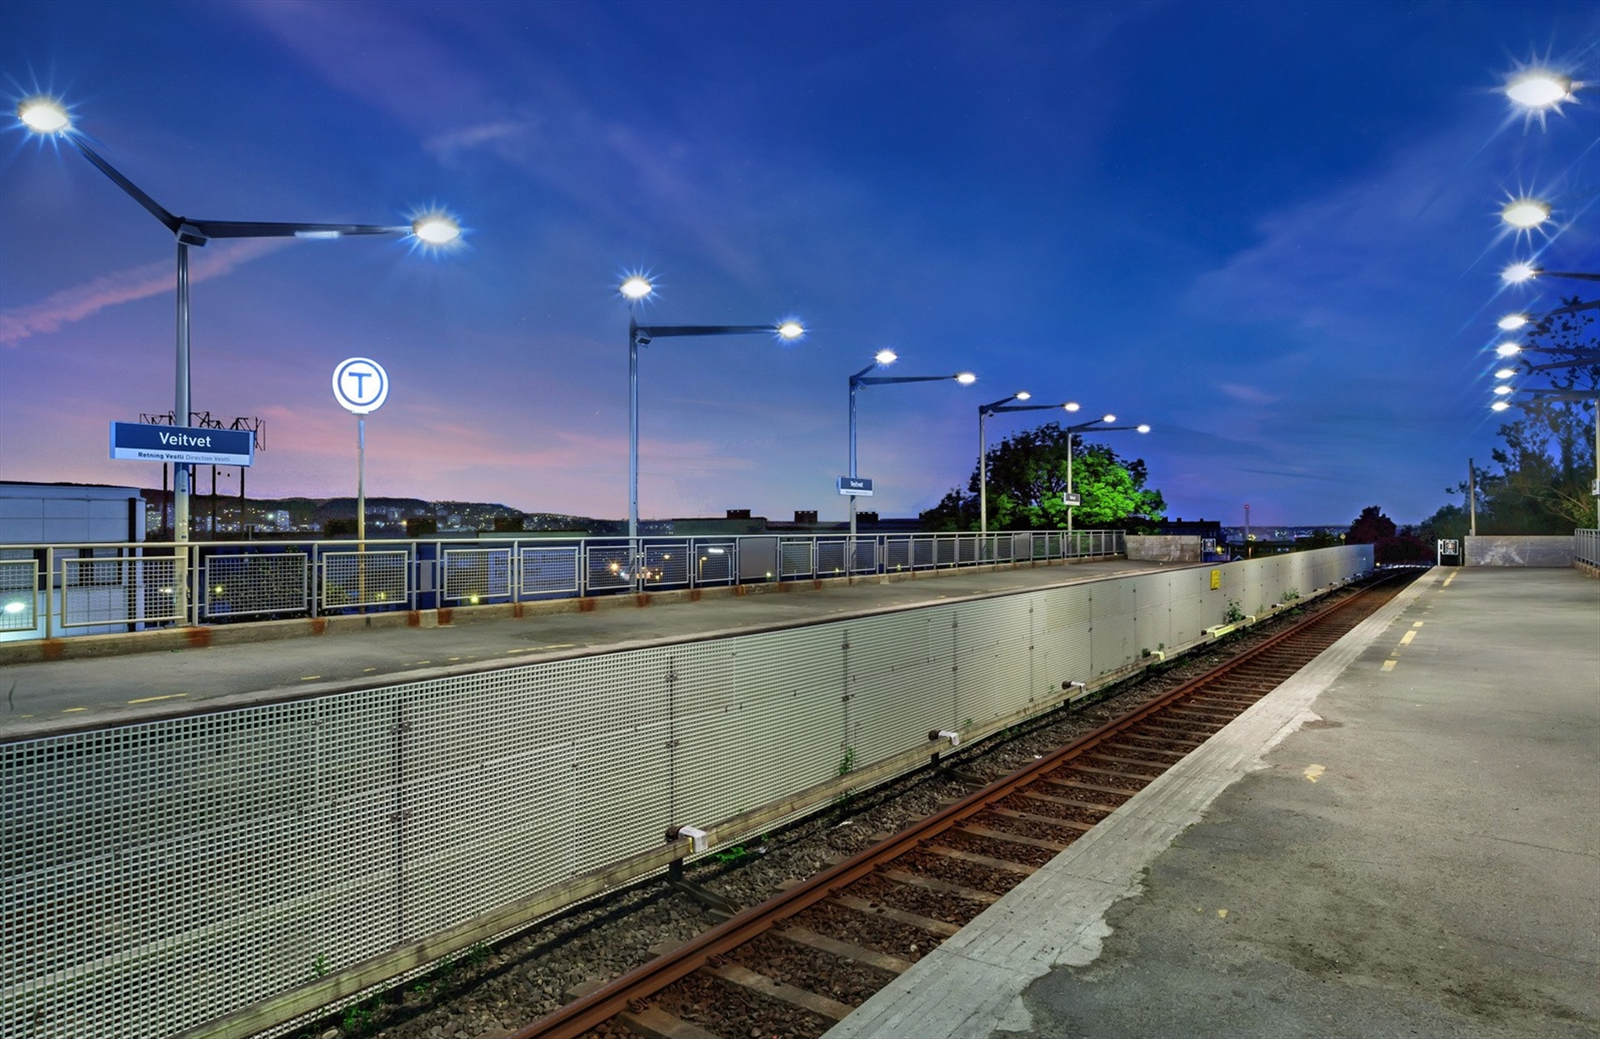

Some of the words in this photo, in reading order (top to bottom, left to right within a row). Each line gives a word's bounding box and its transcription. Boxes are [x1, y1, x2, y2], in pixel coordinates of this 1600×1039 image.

[348, 371, 372, 398] T
[159, 431, 212, 448] Veitvet
[138, 452, 164, 460] Retning
